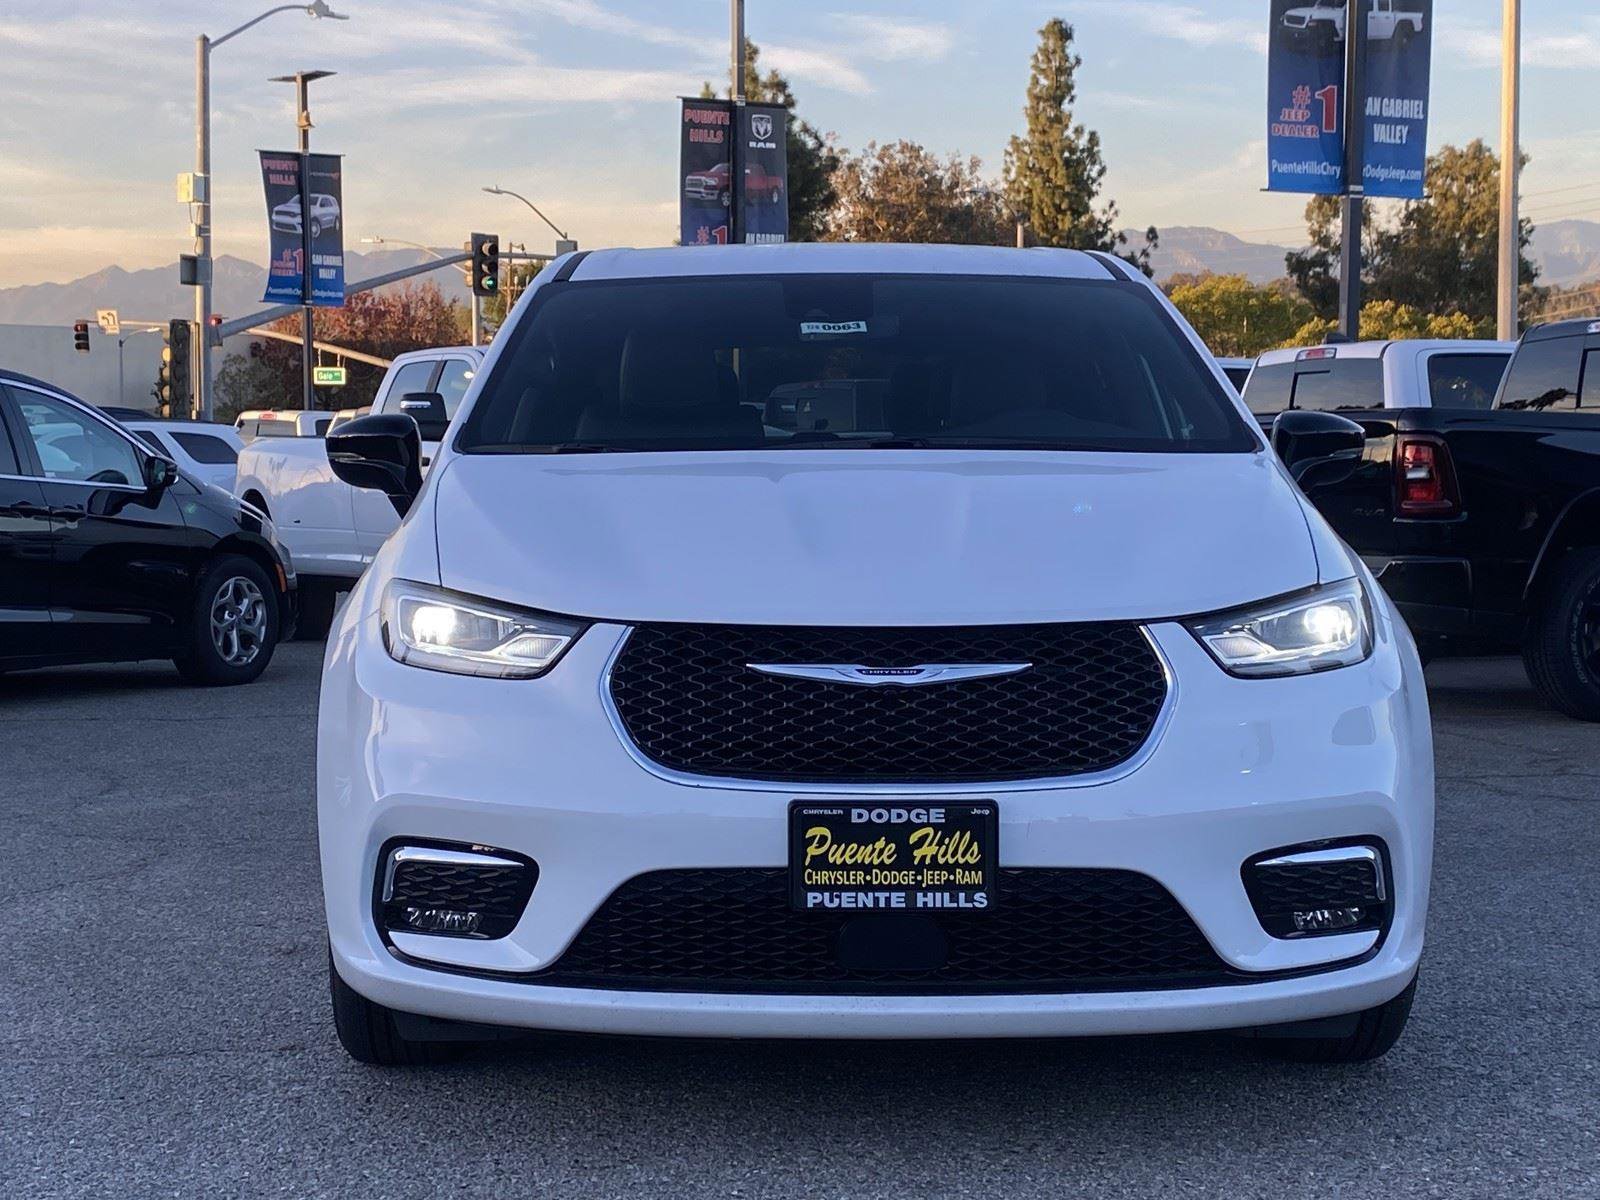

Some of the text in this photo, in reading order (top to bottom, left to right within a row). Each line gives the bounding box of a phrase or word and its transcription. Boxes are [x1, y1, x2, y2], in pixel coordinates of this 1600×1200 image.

[1279, 107, 1311, 122] JEEP
[1365, 96, 1424, 119] AN GABRIEL
[684, 108, 730, 125] PUENTE
[689, 128, 724, 144] HILLS
[1271, 123, 1320, 138] DEALER
[1373, 123, 1409, 144] VALLEY
[749, 141, 776, 149] RAM
[1271, 159, 1341, 179] PuenteHillsChry
[745, 232, 755, 244] AN
[851, 808, 946, 824] DODGE
[970, 808, 990, 816] Jeep
[804, 826, 981, 866] Puente Hills
[807, 892, 988, 908] PUENTE HILLS
